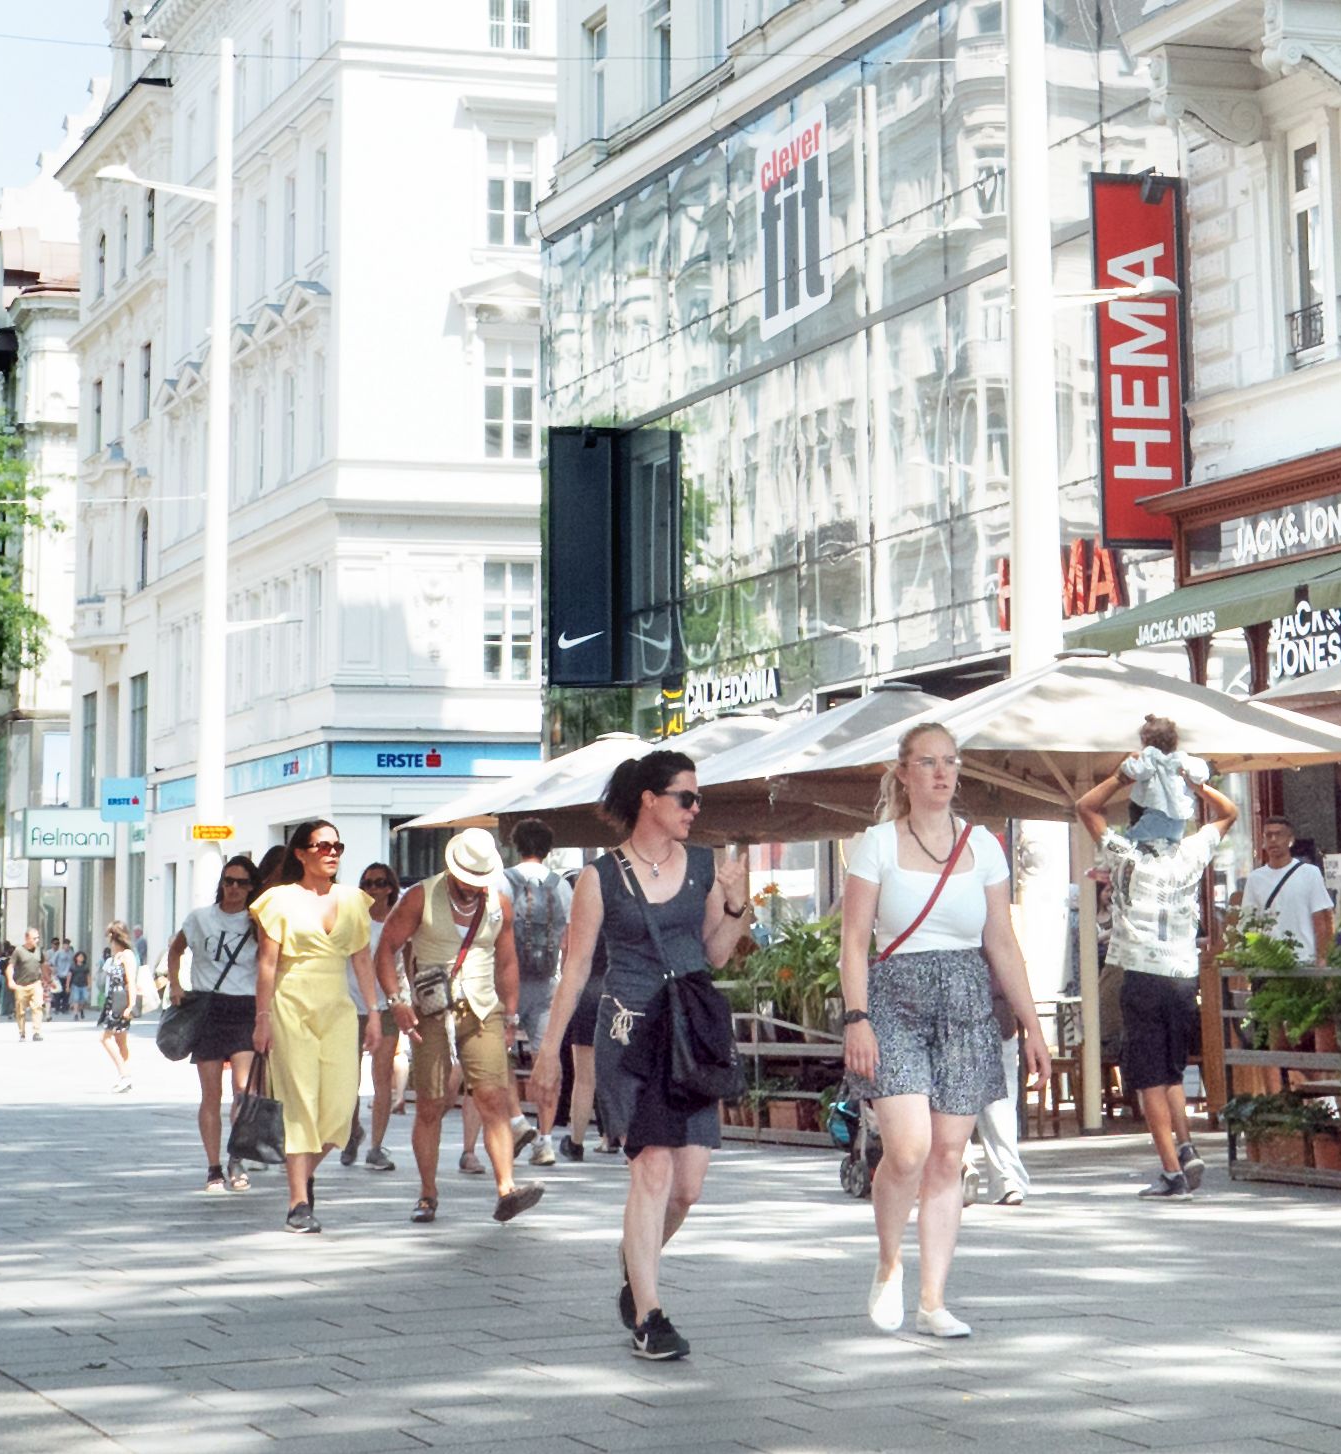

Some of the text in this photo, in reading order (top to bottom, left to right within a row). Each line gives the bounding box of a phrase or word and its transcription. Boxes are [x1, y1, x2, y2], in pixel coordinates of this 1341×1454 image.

[761, 120, 822, 193] clever
[761, 155, 825, 320] fit
[1107, 242, 1172, 480] HEMA
[996, 535, 1121, 632] MA
[1135, 610, 1217, 646] JACK&JONES
[684, 667, 778, 717] CALZEDONIA
[377, 753, 423, 768] ERSTE
[107, 797, 131, 806] ERSTE
[31, 827, 109, 846] fielmann
